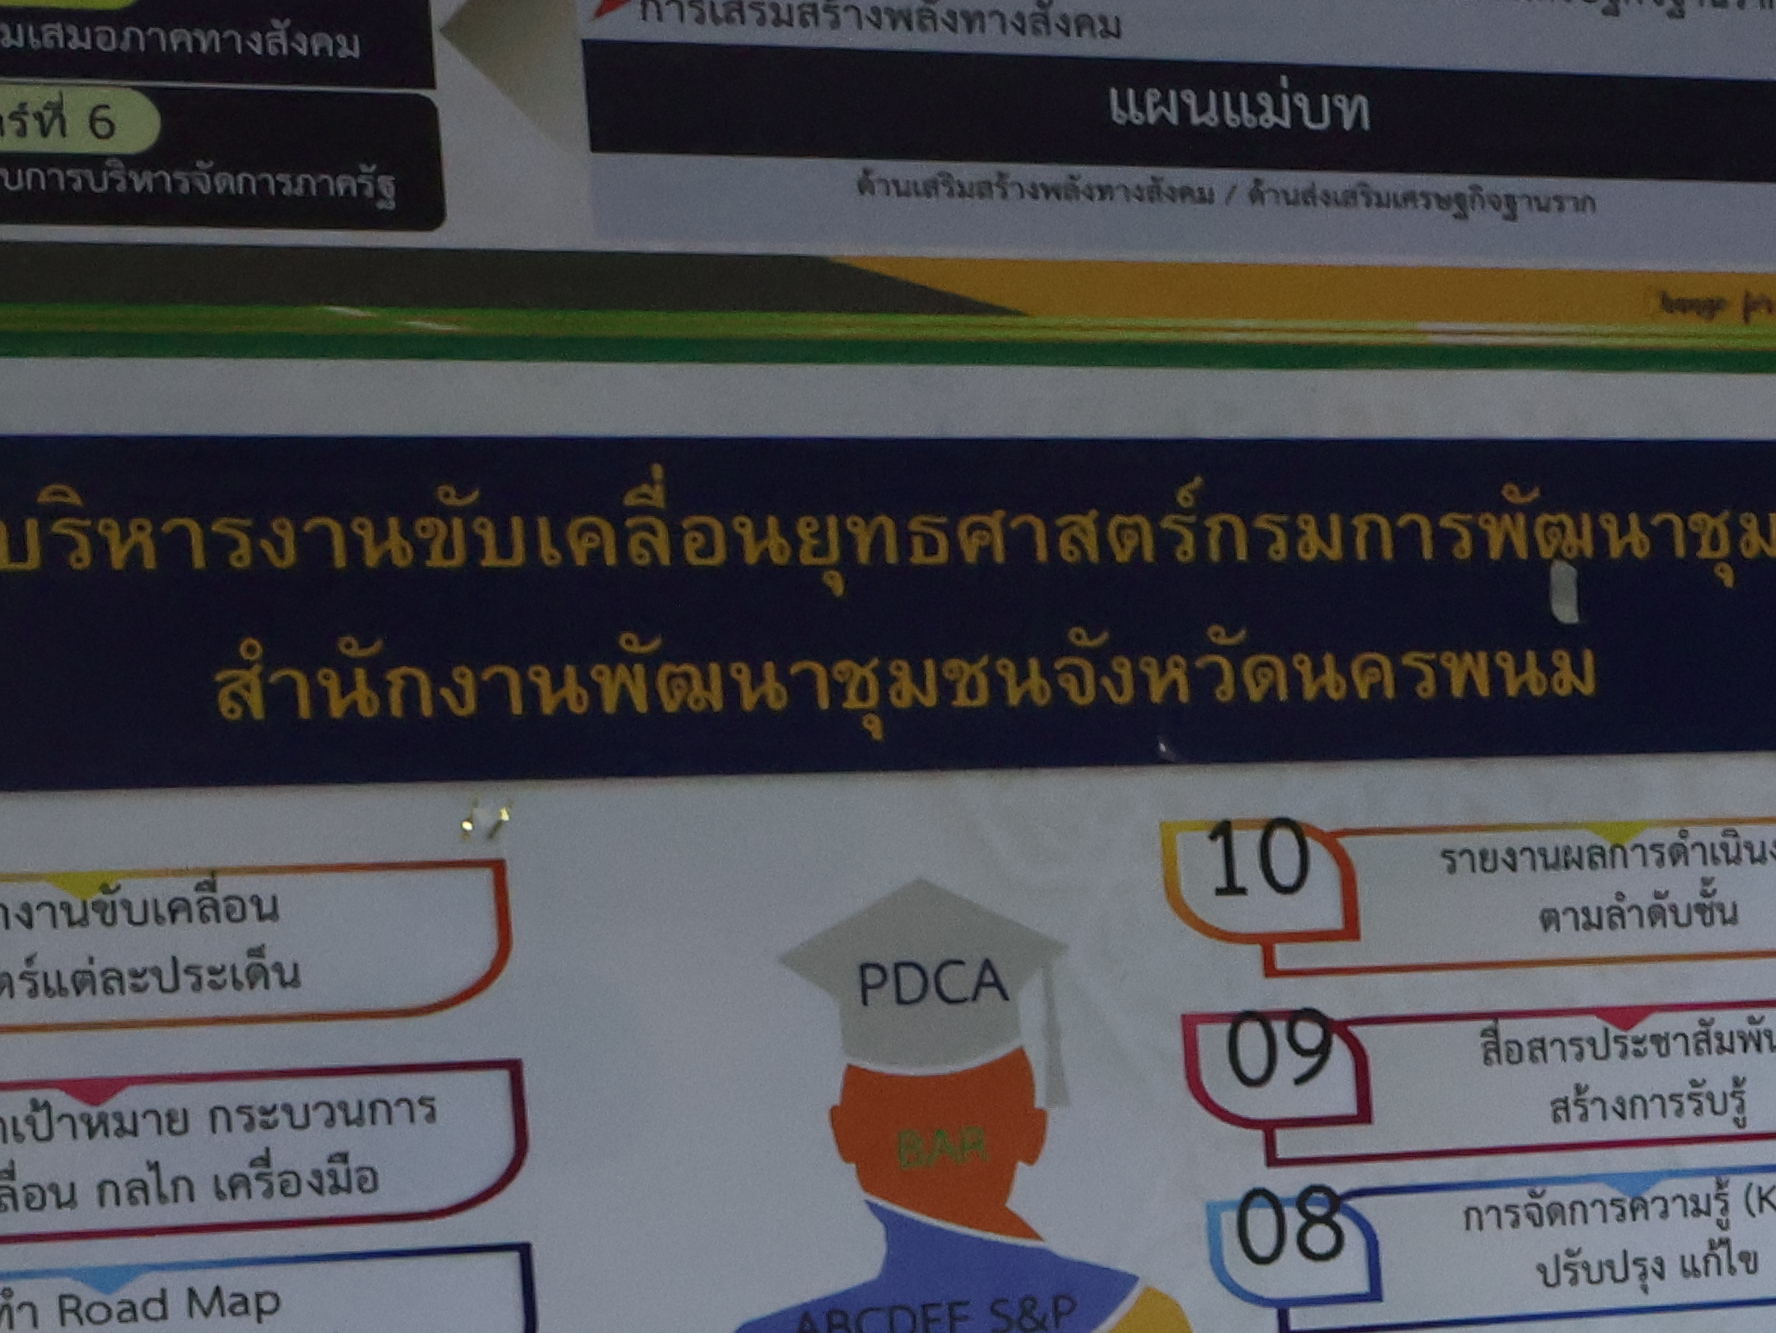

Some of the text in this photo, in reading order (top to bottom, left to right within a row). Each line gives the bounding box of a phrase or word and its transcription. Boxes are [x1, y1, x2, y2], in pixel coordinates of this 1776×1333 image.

[0, 90, 116, 140] ร์ที่ 6
[1108, 75, 1372, 132] แผนแม่บท
[213, 623, 1598, 741] สำนักงานพัฒนาชุมชนจังหวัดนครพนม
[1206, 816, 1310, 897] 10
[1540, 877, 1739, 933] ตามลำดับชั้น
[858, 960, 1010, 1006] PDCA
[1227, 1008, 1334, 1089] 09
[209, 1094, 438, 1136] กระบวนการ
[1549, 1076, 1748, 1129] สร้างการรับรู้
[896, 1125, 989, 1170] BAR
[97, 1160, 195, 1208] กลไก
[213, 1146, 379, 1201] เครื่องมือ
[1463, 1176, 1732, 1233] การจัดการความรู้
[1236, 1184, 1345, 1267] 08
[1537, 1239, 1759, 1298] ปรับปรุง แก้ไข
[57, 1287, 169, 1327] Road
[187, 1284, 282, 1324] Map
